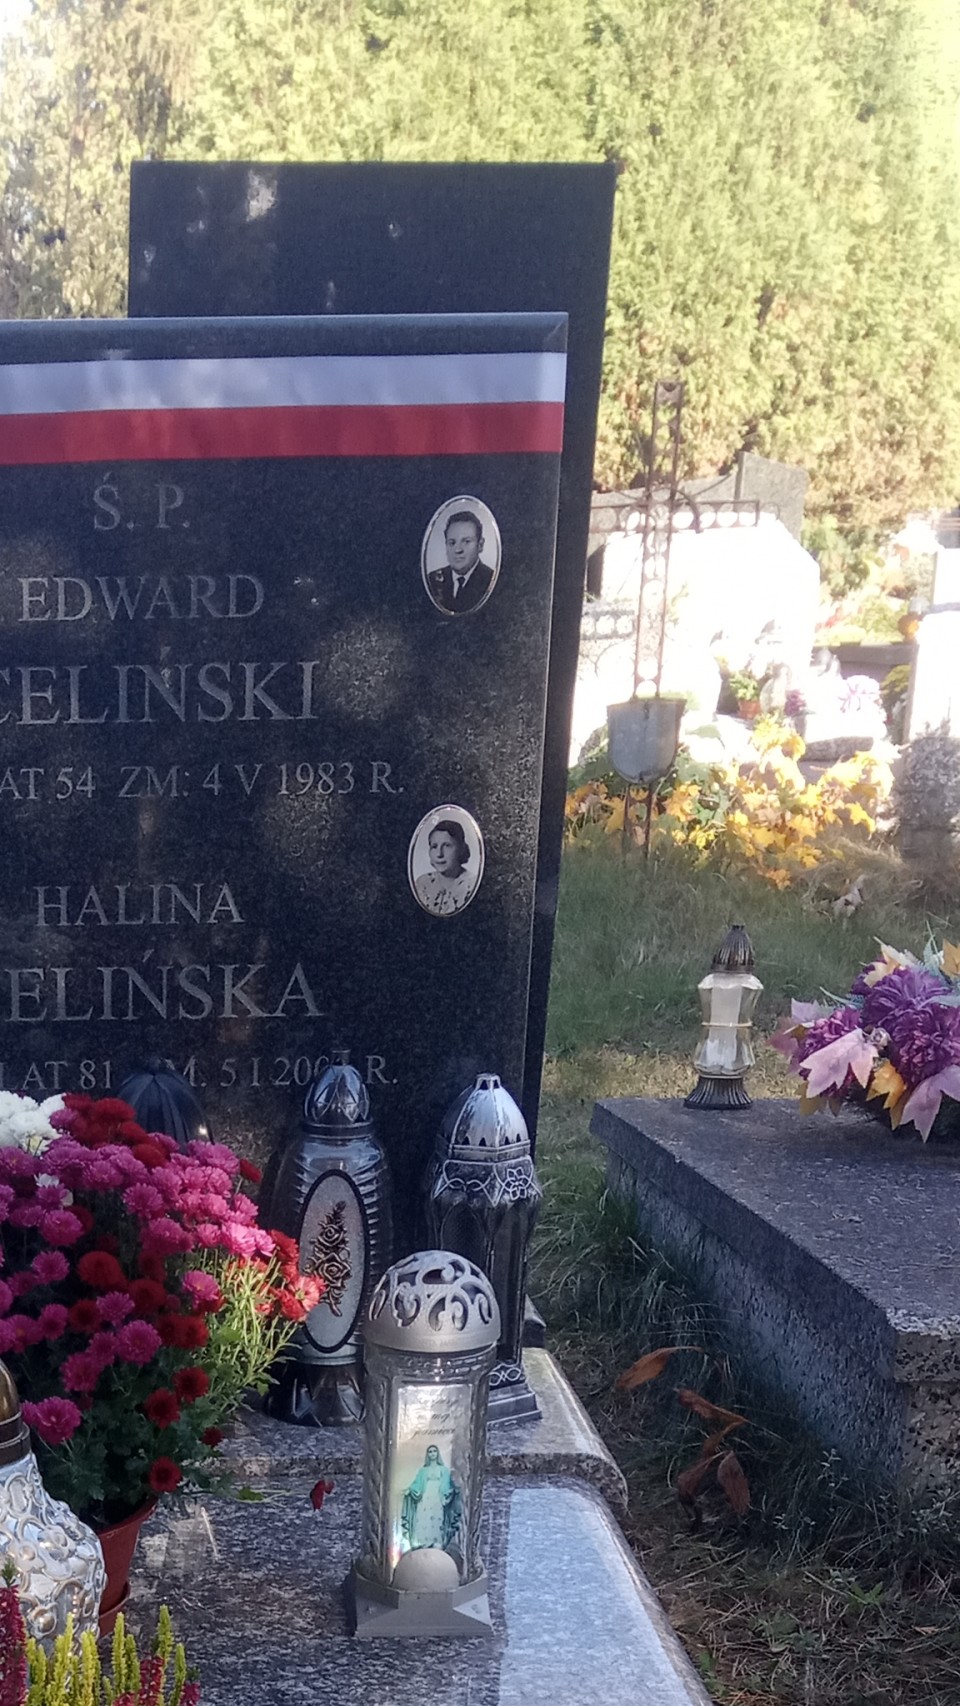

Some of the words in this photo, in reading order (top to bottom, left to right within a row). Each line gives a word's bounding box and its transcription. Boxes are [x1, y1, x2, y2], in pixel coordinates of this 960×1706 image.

[17, 574, 265, 622] EDWARD
[55, 766, 96, 800] 54
[202, 763, 223, 796] 4
[234, 763, 263, 796] V
[276, 761, 355, 796] 1983
[369, 760, 404, 794] R.
[33, 882, 246, 927] HALINA
[78, 1059, 113, 1090] 81
[220, 1058, 237, 1088] 5
[250, 1056, 262, 1087] I
[364, 1054, 399, 1085] R.
